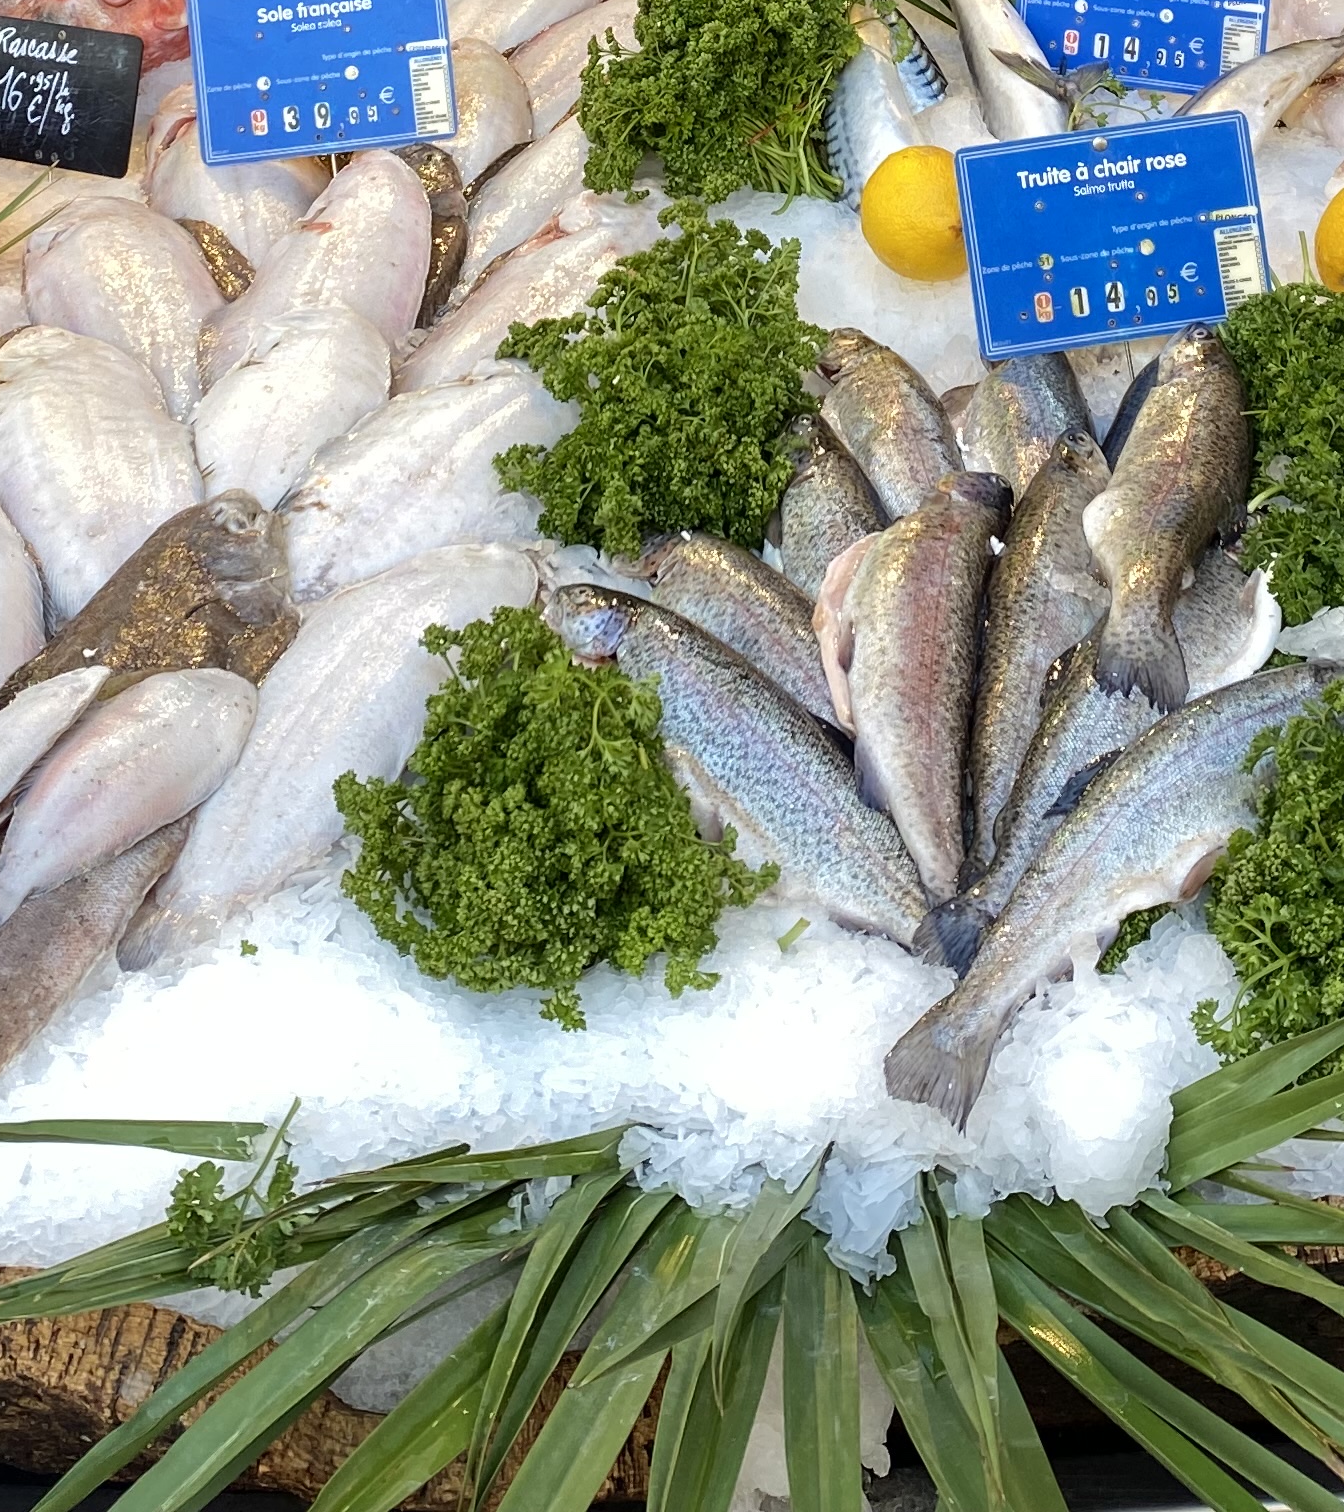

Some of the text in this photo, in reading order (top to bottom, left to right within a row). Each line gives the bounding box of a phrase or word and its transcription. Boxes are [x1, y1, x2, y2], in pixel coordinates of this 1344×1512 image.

[256, 4, 294, 24] Sole
[290, 22, 316, 33] Solea
[1188, 37, 1205, 55] €
[379, 86, 396, 104] €
[1016, 151, 1188, 190] Truite à chair rose
[1073, 179, 1135, 197] Salmo trutta
[1180, 262, 1200, 282] €
